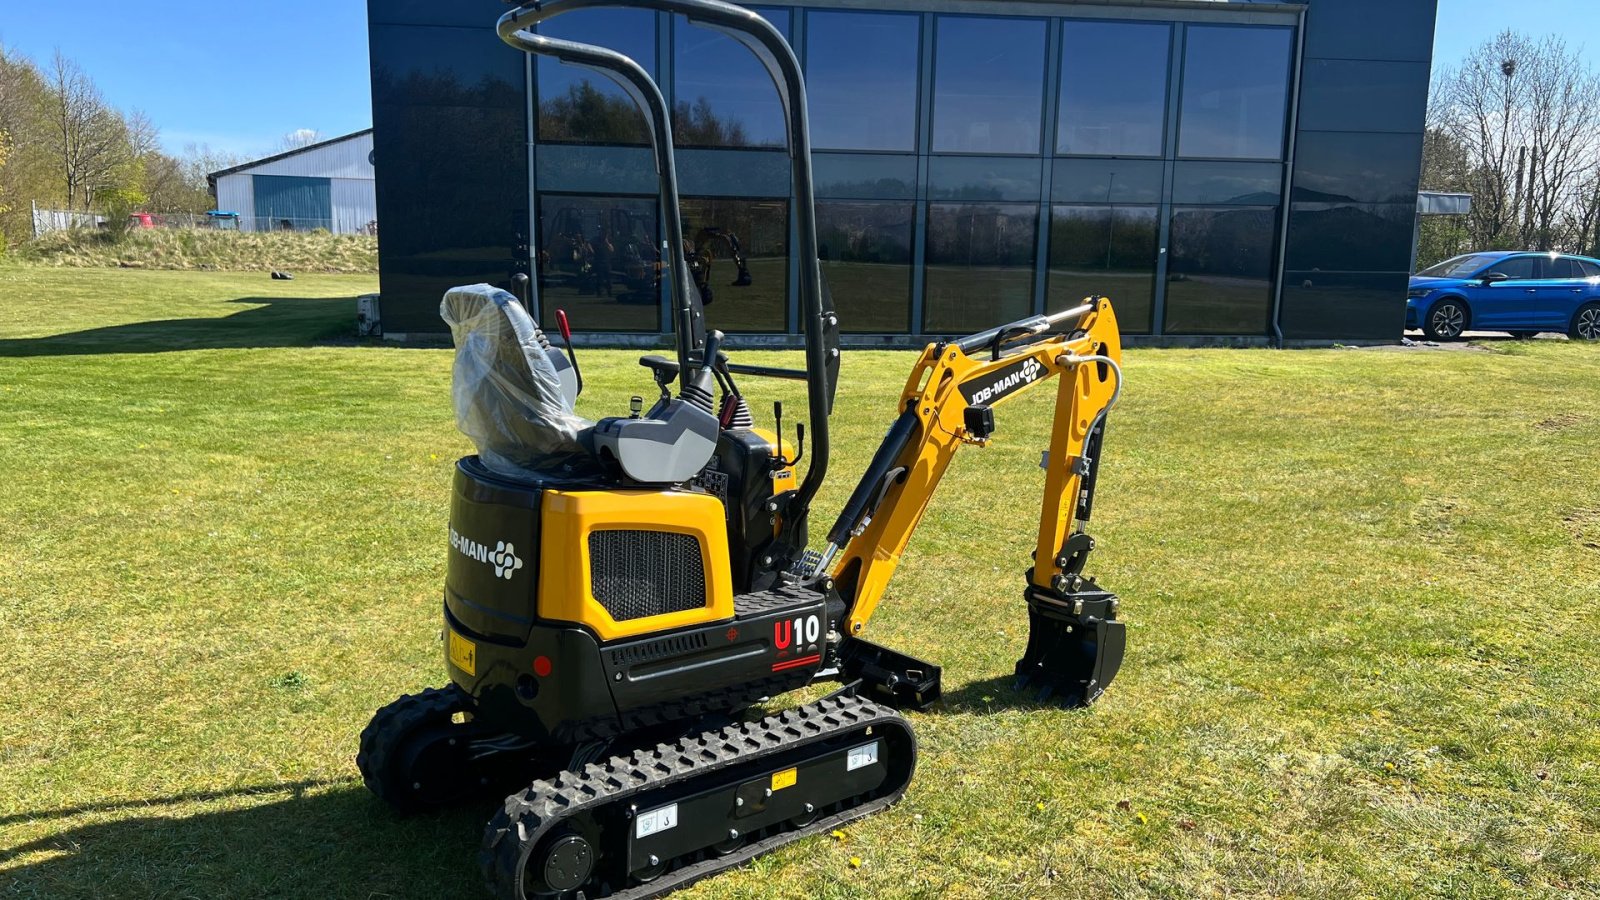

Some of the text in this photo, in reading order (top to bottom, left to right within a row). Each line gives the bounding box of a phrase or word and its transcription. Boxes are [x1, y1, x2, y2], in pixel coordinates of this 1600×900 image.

[971, 371, 1020, 406] JOB-MAN
[449, 528, 487, 564] OB-MAN
[774, 614, 820, 650] U10
